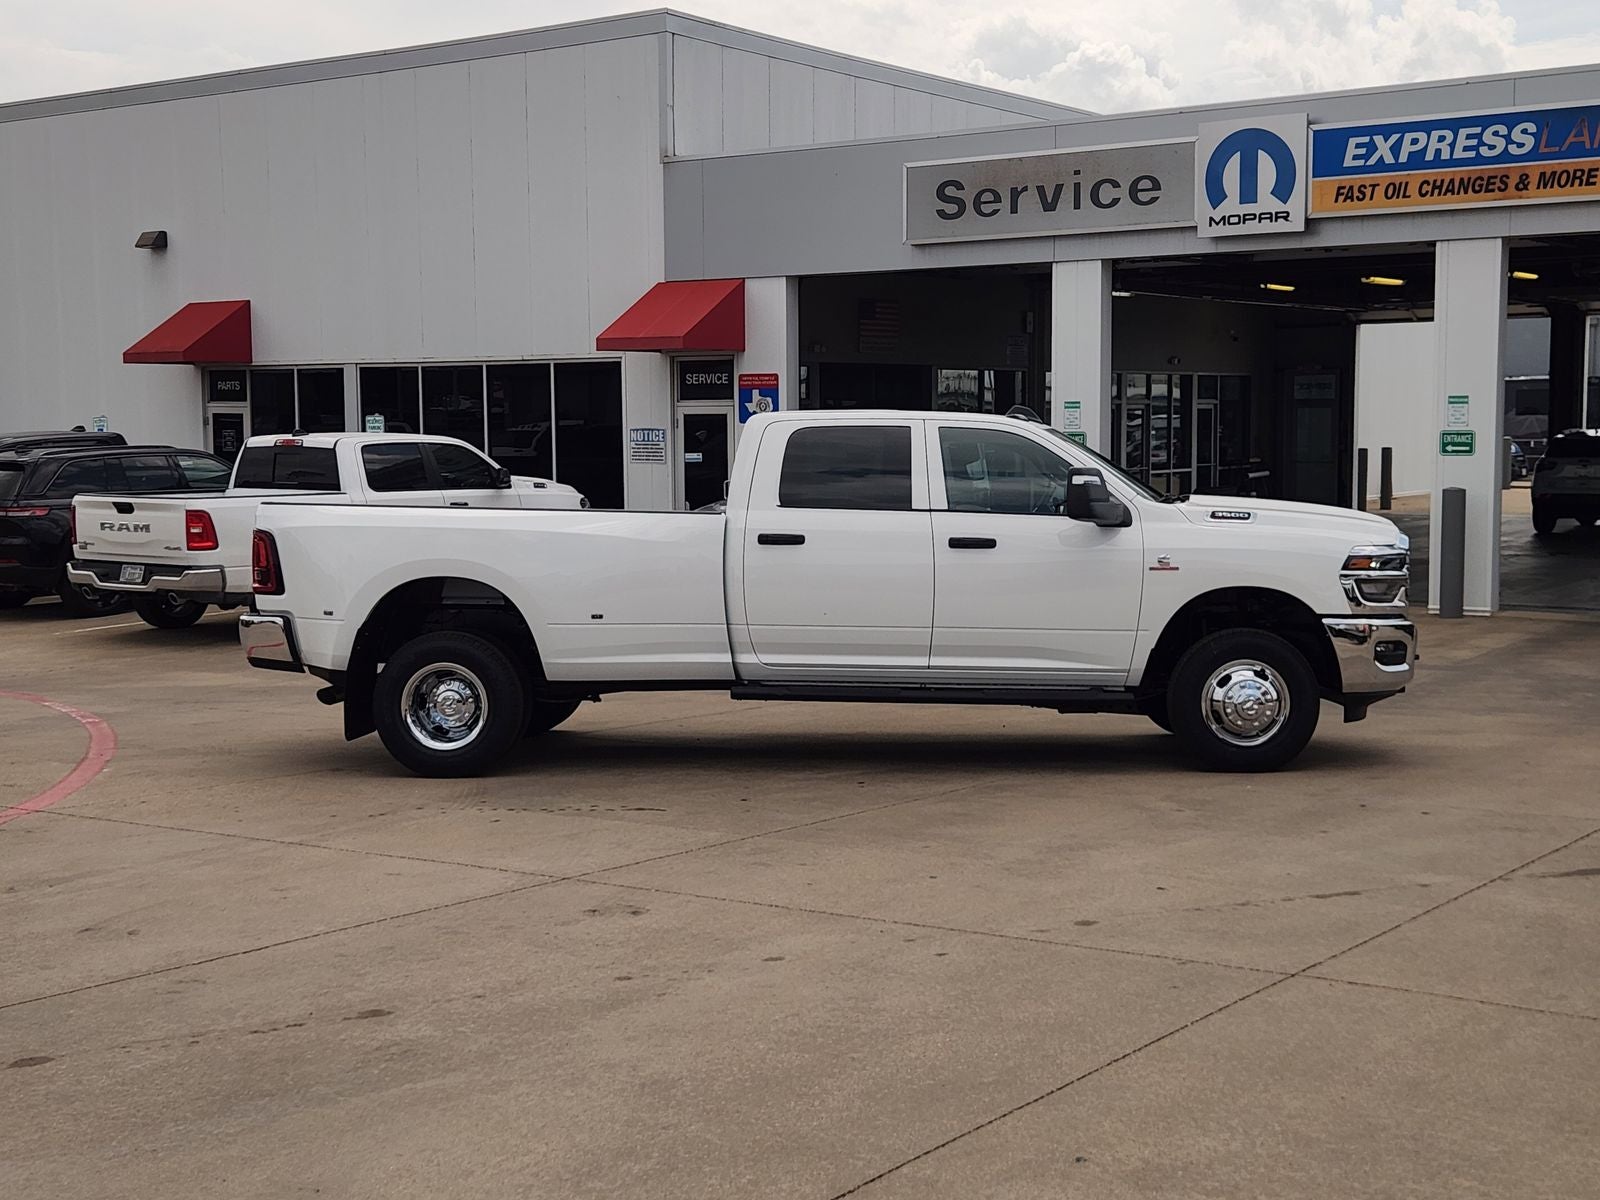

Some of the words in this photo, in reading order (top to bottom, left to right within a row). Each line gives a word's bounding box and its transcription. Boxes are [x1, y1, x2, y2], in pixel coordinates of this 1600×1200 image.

[1343, 121, 1537, 168] EXPRESS
[1334, 182, 1379, 203] FAST
[1384, 181, 1411, 200] OIL
[1417, 173, 1510, 198] CHANGES
[1514, 172, 1530, 191] &
[1536, 167, 1600, 190] MORE
[935, 169, 1162, 220] Service
[1208, 210, 1293, 228] MOPAR
[685, 373, 729, 384] SERVICE
[217, 381, 240, 391] PARTS
[630, 430, 664, 441] NOTICE
[1443, 434, 1473, 443] ENTRANCE
[100, 521, 151, 533] RAM
